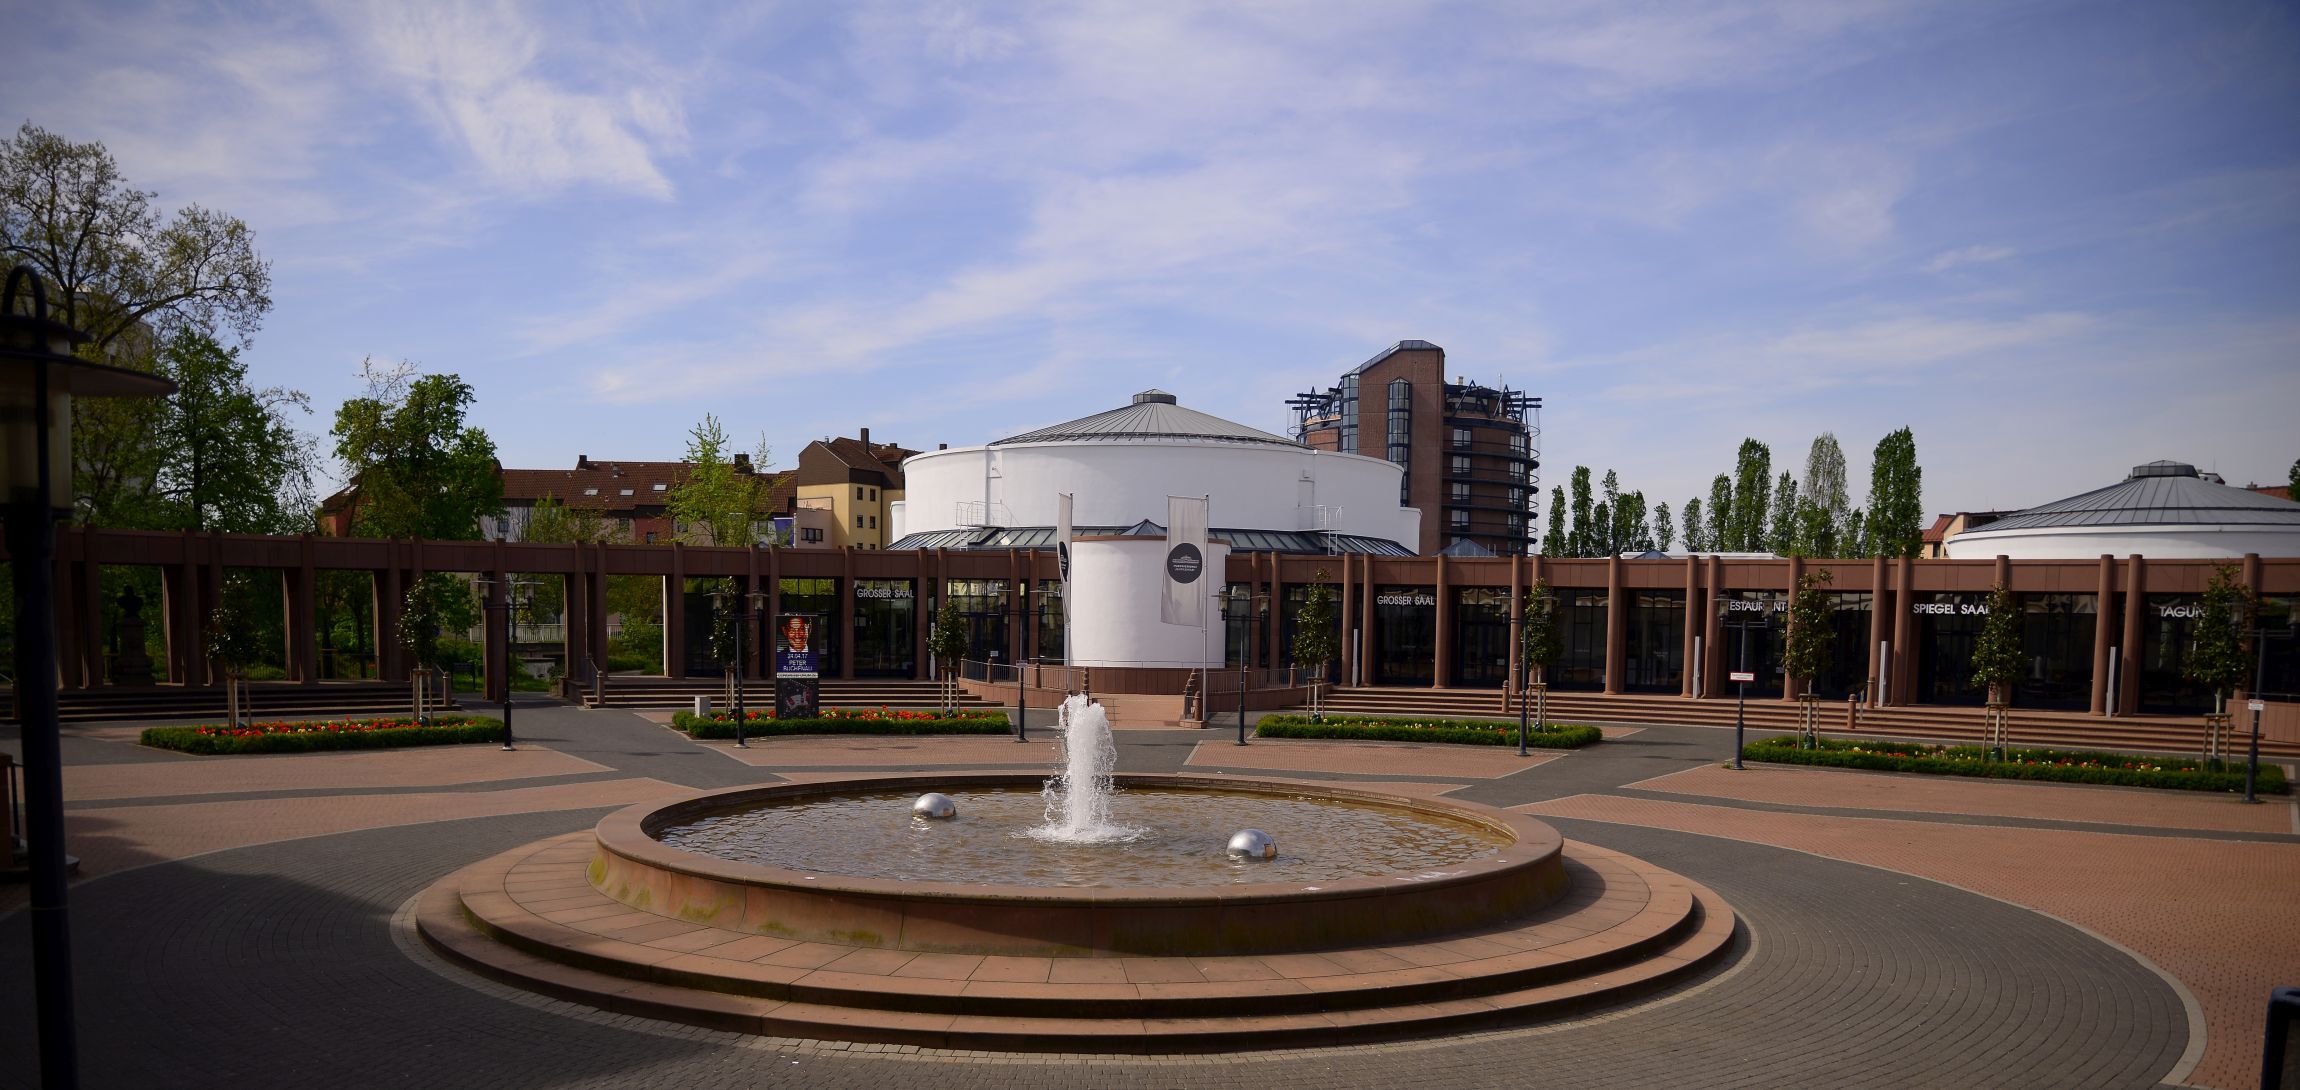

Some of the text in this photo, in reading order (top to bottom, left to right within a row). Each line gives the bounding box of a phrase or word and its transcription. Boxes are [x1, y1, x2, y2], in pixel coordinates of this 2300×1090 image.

[857, 589, 914, 598] GROSSER SAAL
[1377, 595, 1435, 606] GROSSER SAAL
[1729, 601, 1787, 612] ESTAURNT
[1913, 603, 1956, 615] SPIEGEL
[2160, 606, 2206, 618] TAGUN
